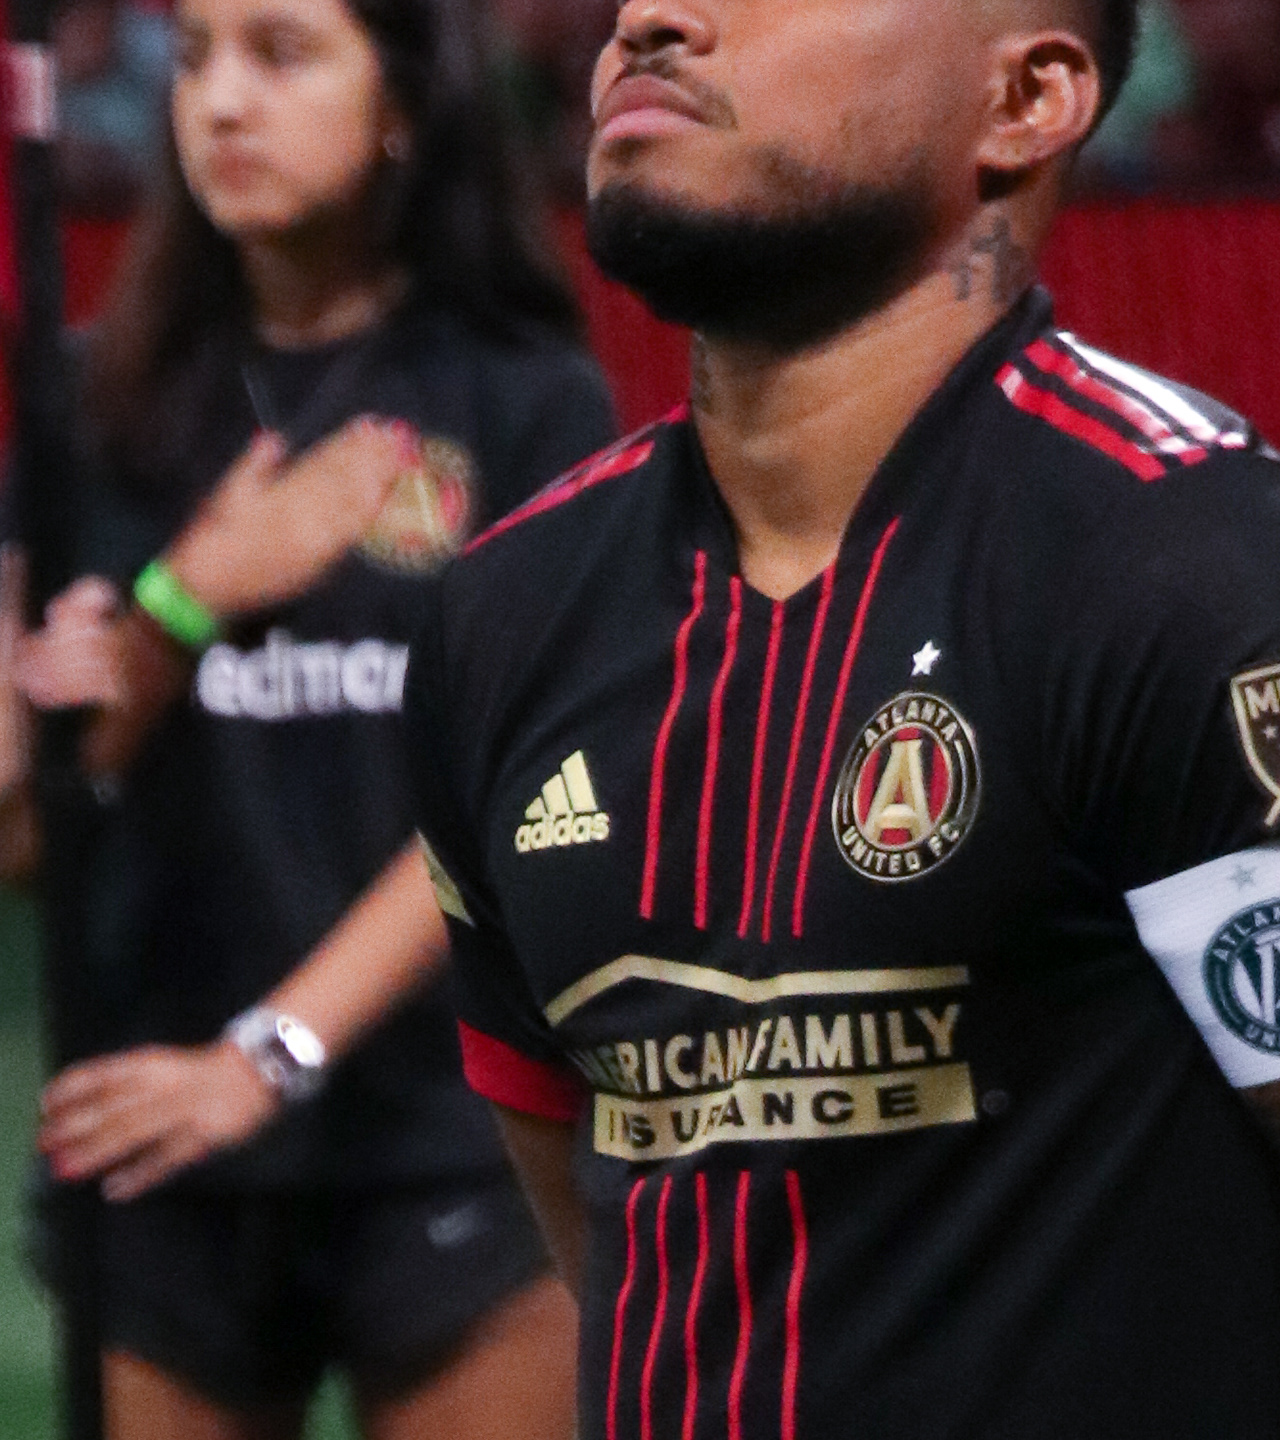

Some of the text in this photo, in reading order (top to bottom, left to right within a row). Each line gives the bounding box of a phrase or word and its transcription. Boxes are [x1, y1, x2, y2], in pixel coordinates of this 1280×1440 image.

[863, 699, 958, 749] ATLANTA
[514, 810, 611, 854] adidas
[841, 822, 960, 876] UNITED FC
[746, 1003, 962, 1072] FAMILY
